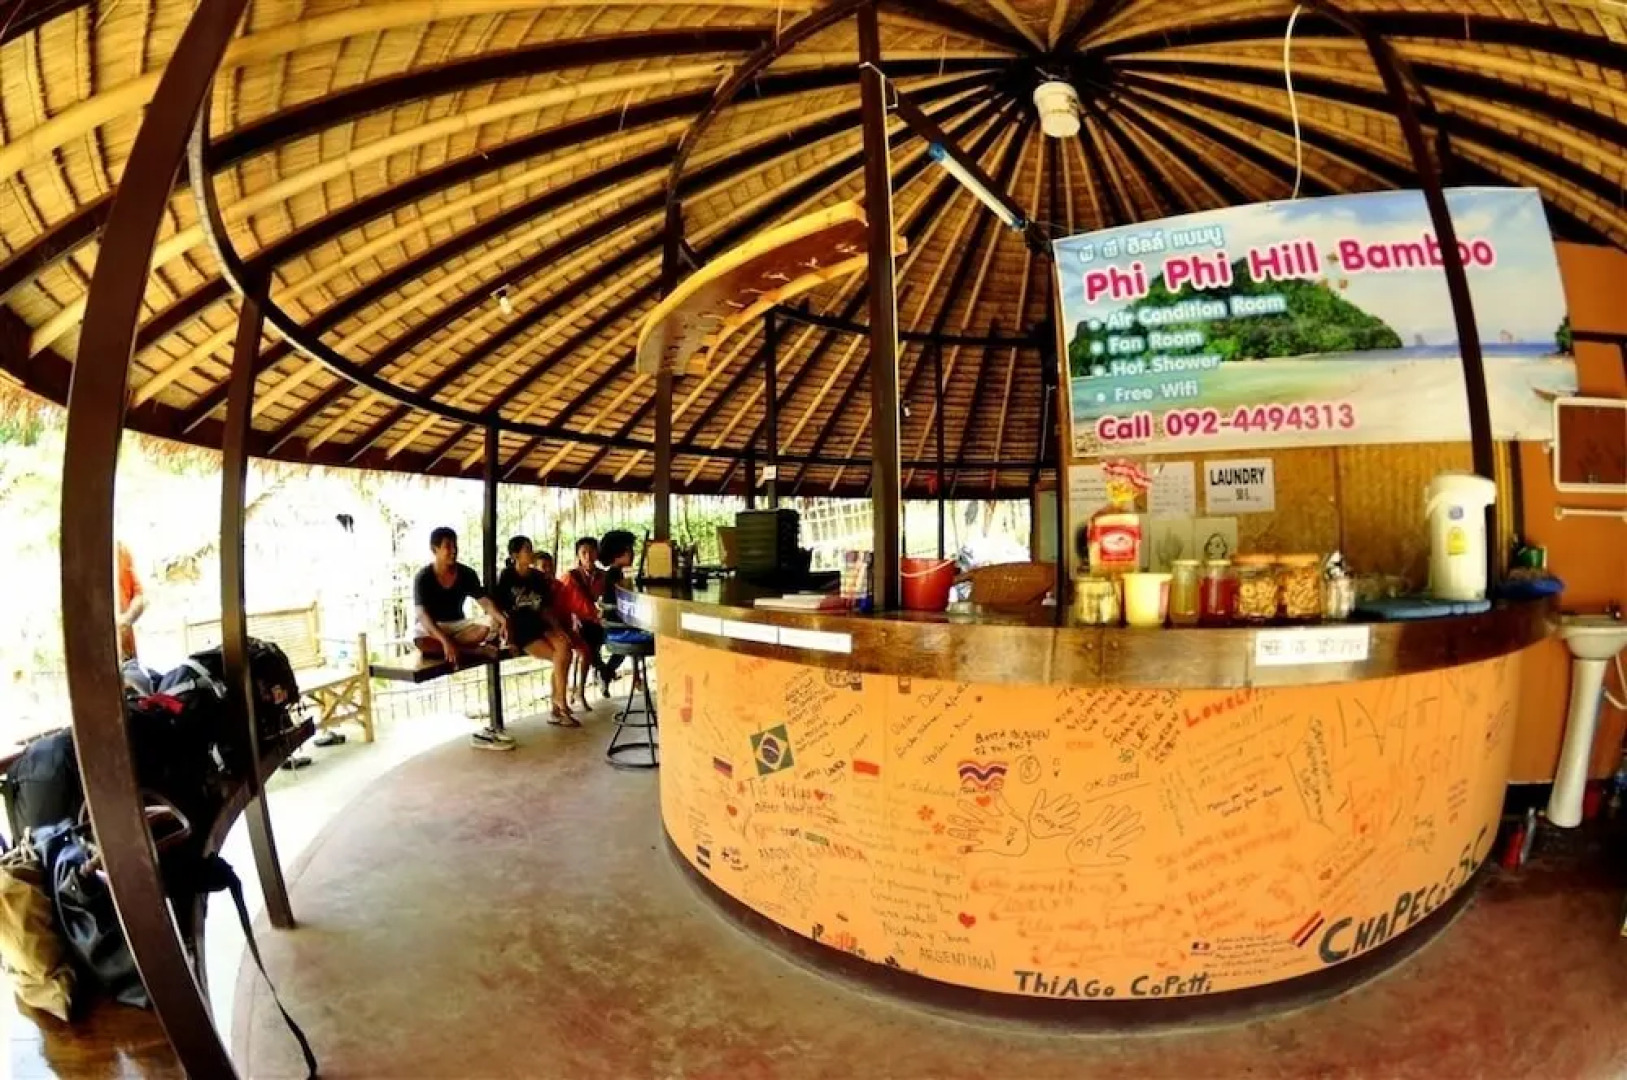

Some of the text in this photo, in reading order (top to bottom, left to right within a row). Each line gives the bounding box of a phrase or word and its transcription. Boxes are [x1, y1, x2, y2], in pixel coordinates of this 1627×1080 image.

[1085, 262, 1146, 302] Phi
[1165, 252, 1230, 290] Phi
[1249, 240, 1319, 279] Hill
[1107, 295, 1286, 331] Air Condition Room
[1110, 331, 1203, 354] Fan Room
[1112, 354, 1221, 377] Hot Shower
[1115, 380, 1198, 402] Free Wifi
[1099, 403, 1356, 440] Call 092-4494313
[1210, 467, 1265, 486] LAUNDRY
